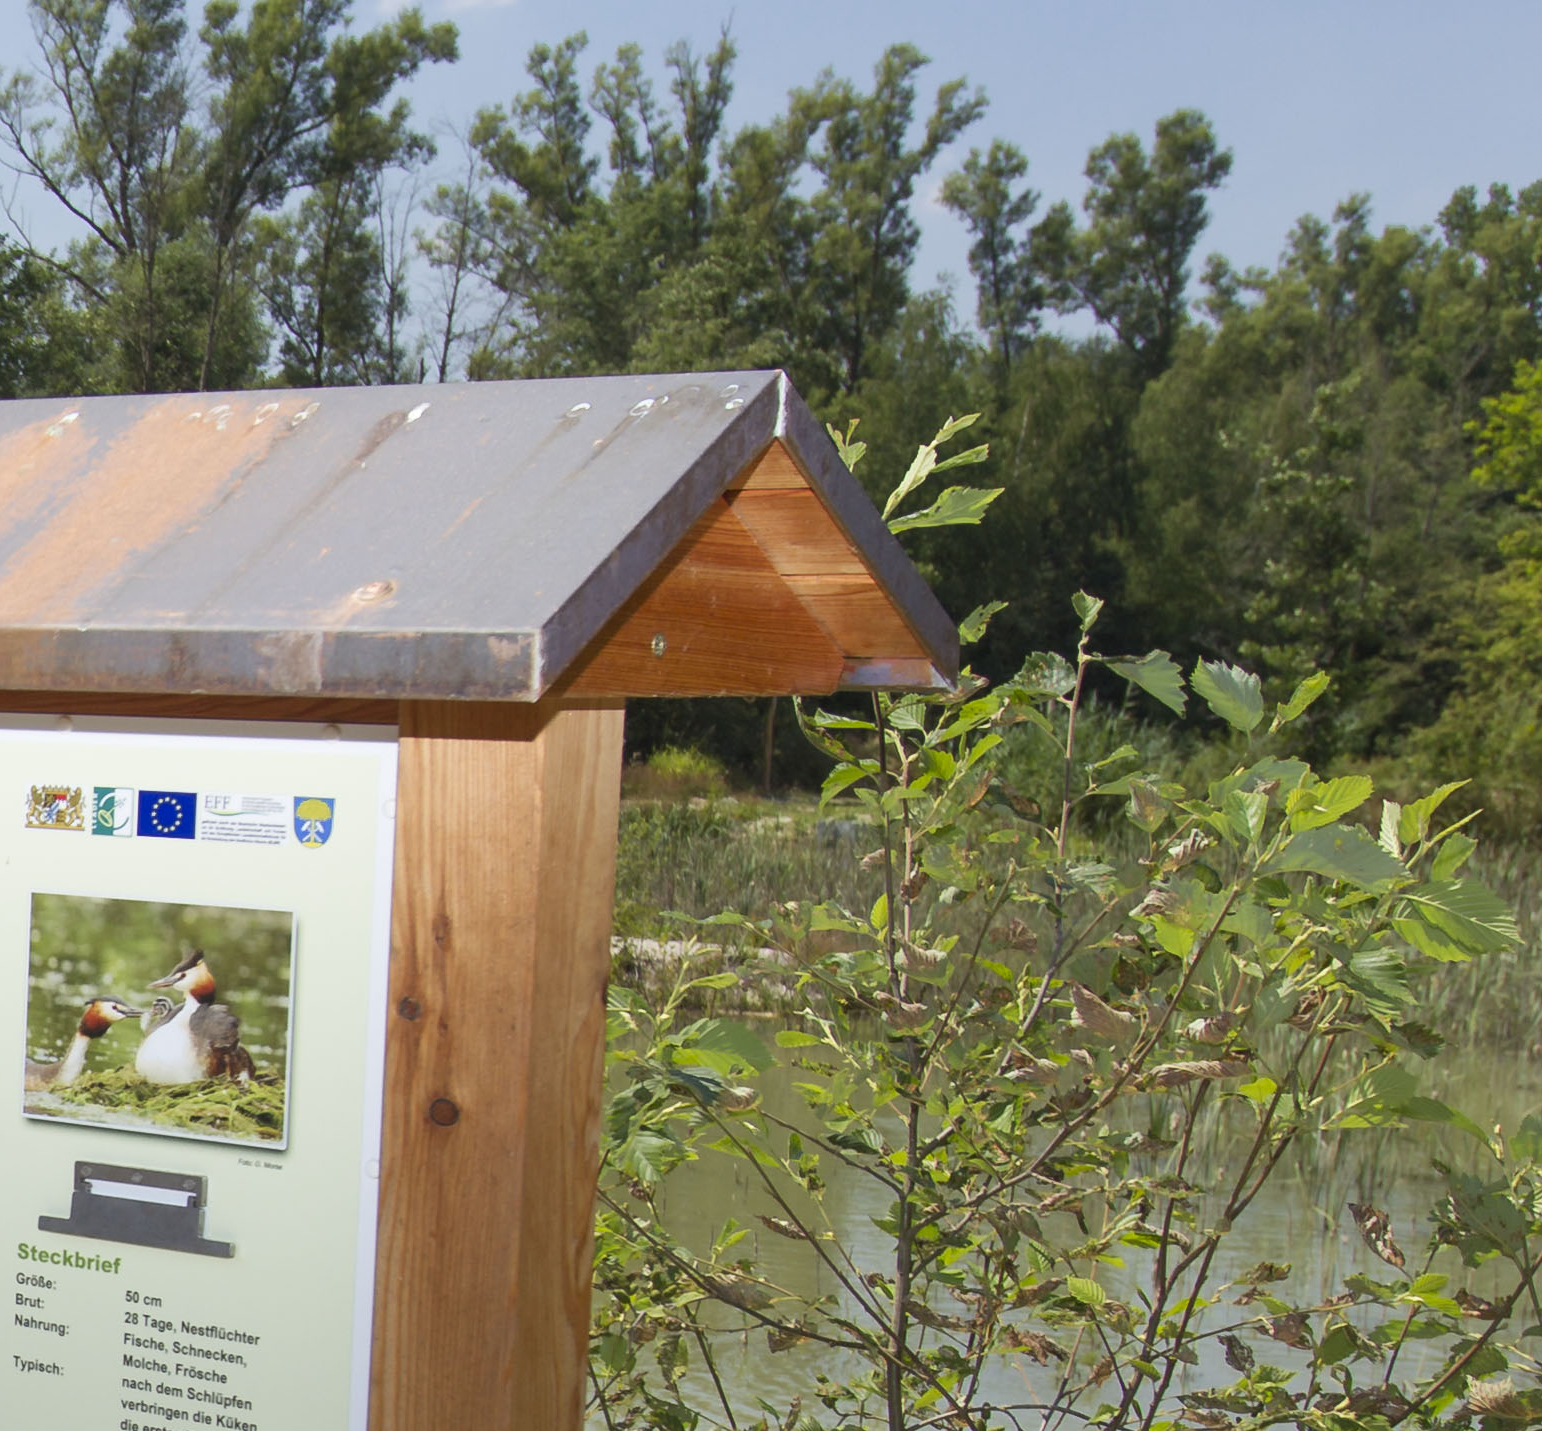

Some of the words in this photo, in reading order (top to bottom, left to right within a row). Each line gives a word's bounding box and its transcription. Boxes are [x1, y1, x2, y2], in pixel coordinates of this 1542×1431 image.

[17, 1244, 122, 1274] Steckbrief
[124, 1312, 139, 1326] 28
[143, 1315, 177, 1334] Tage,
[181, 1321, 260, 1346] Nestflüchter
[124, 1334, 168, 1353] Fische,
[172, 1342, 248, 1368] Schnecken,
[122, 1354, 172, 1376] Molche,
[175, 1363, 228, 1384] Frösche
[122, 1377, 153, 1394] nach
[156, 1383, 183, 1399] dem
[187, 1387, 253, 1412] Schlüpfen
[121, 1399, 189, 1423] verbringen
[192, 1411, 213, 1426] die
